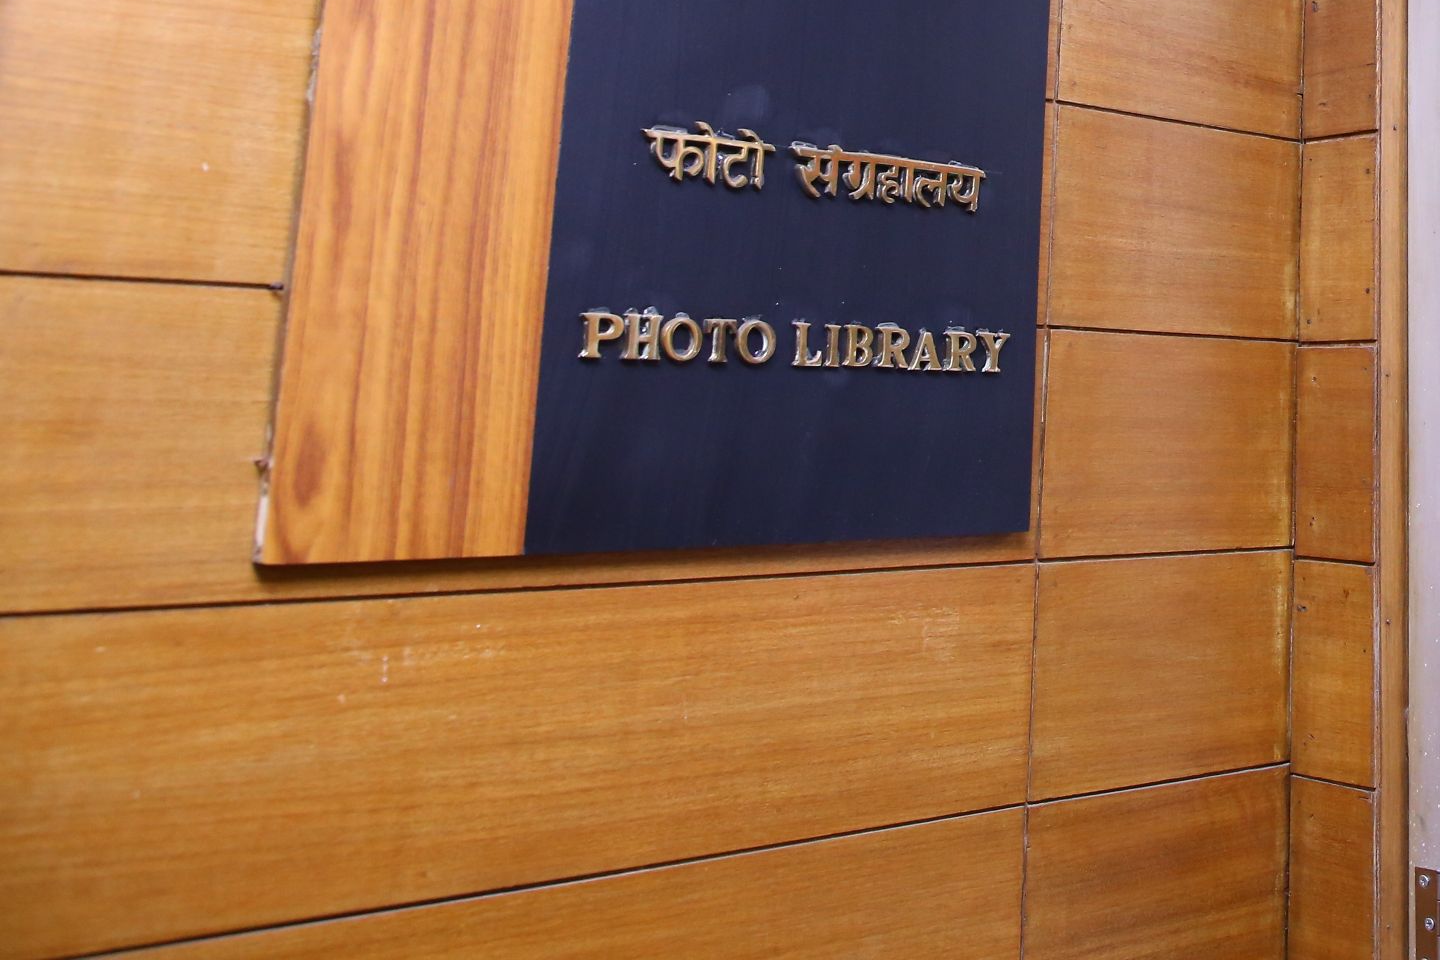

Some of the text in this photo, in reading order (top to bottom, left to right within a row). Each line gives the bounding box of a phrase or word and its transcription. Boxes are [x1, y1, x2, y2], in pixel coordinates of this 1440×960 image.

[641, 121, 776, 190] फोटो
[578, 309, 1010, 373] PHOTO LIBRARY
